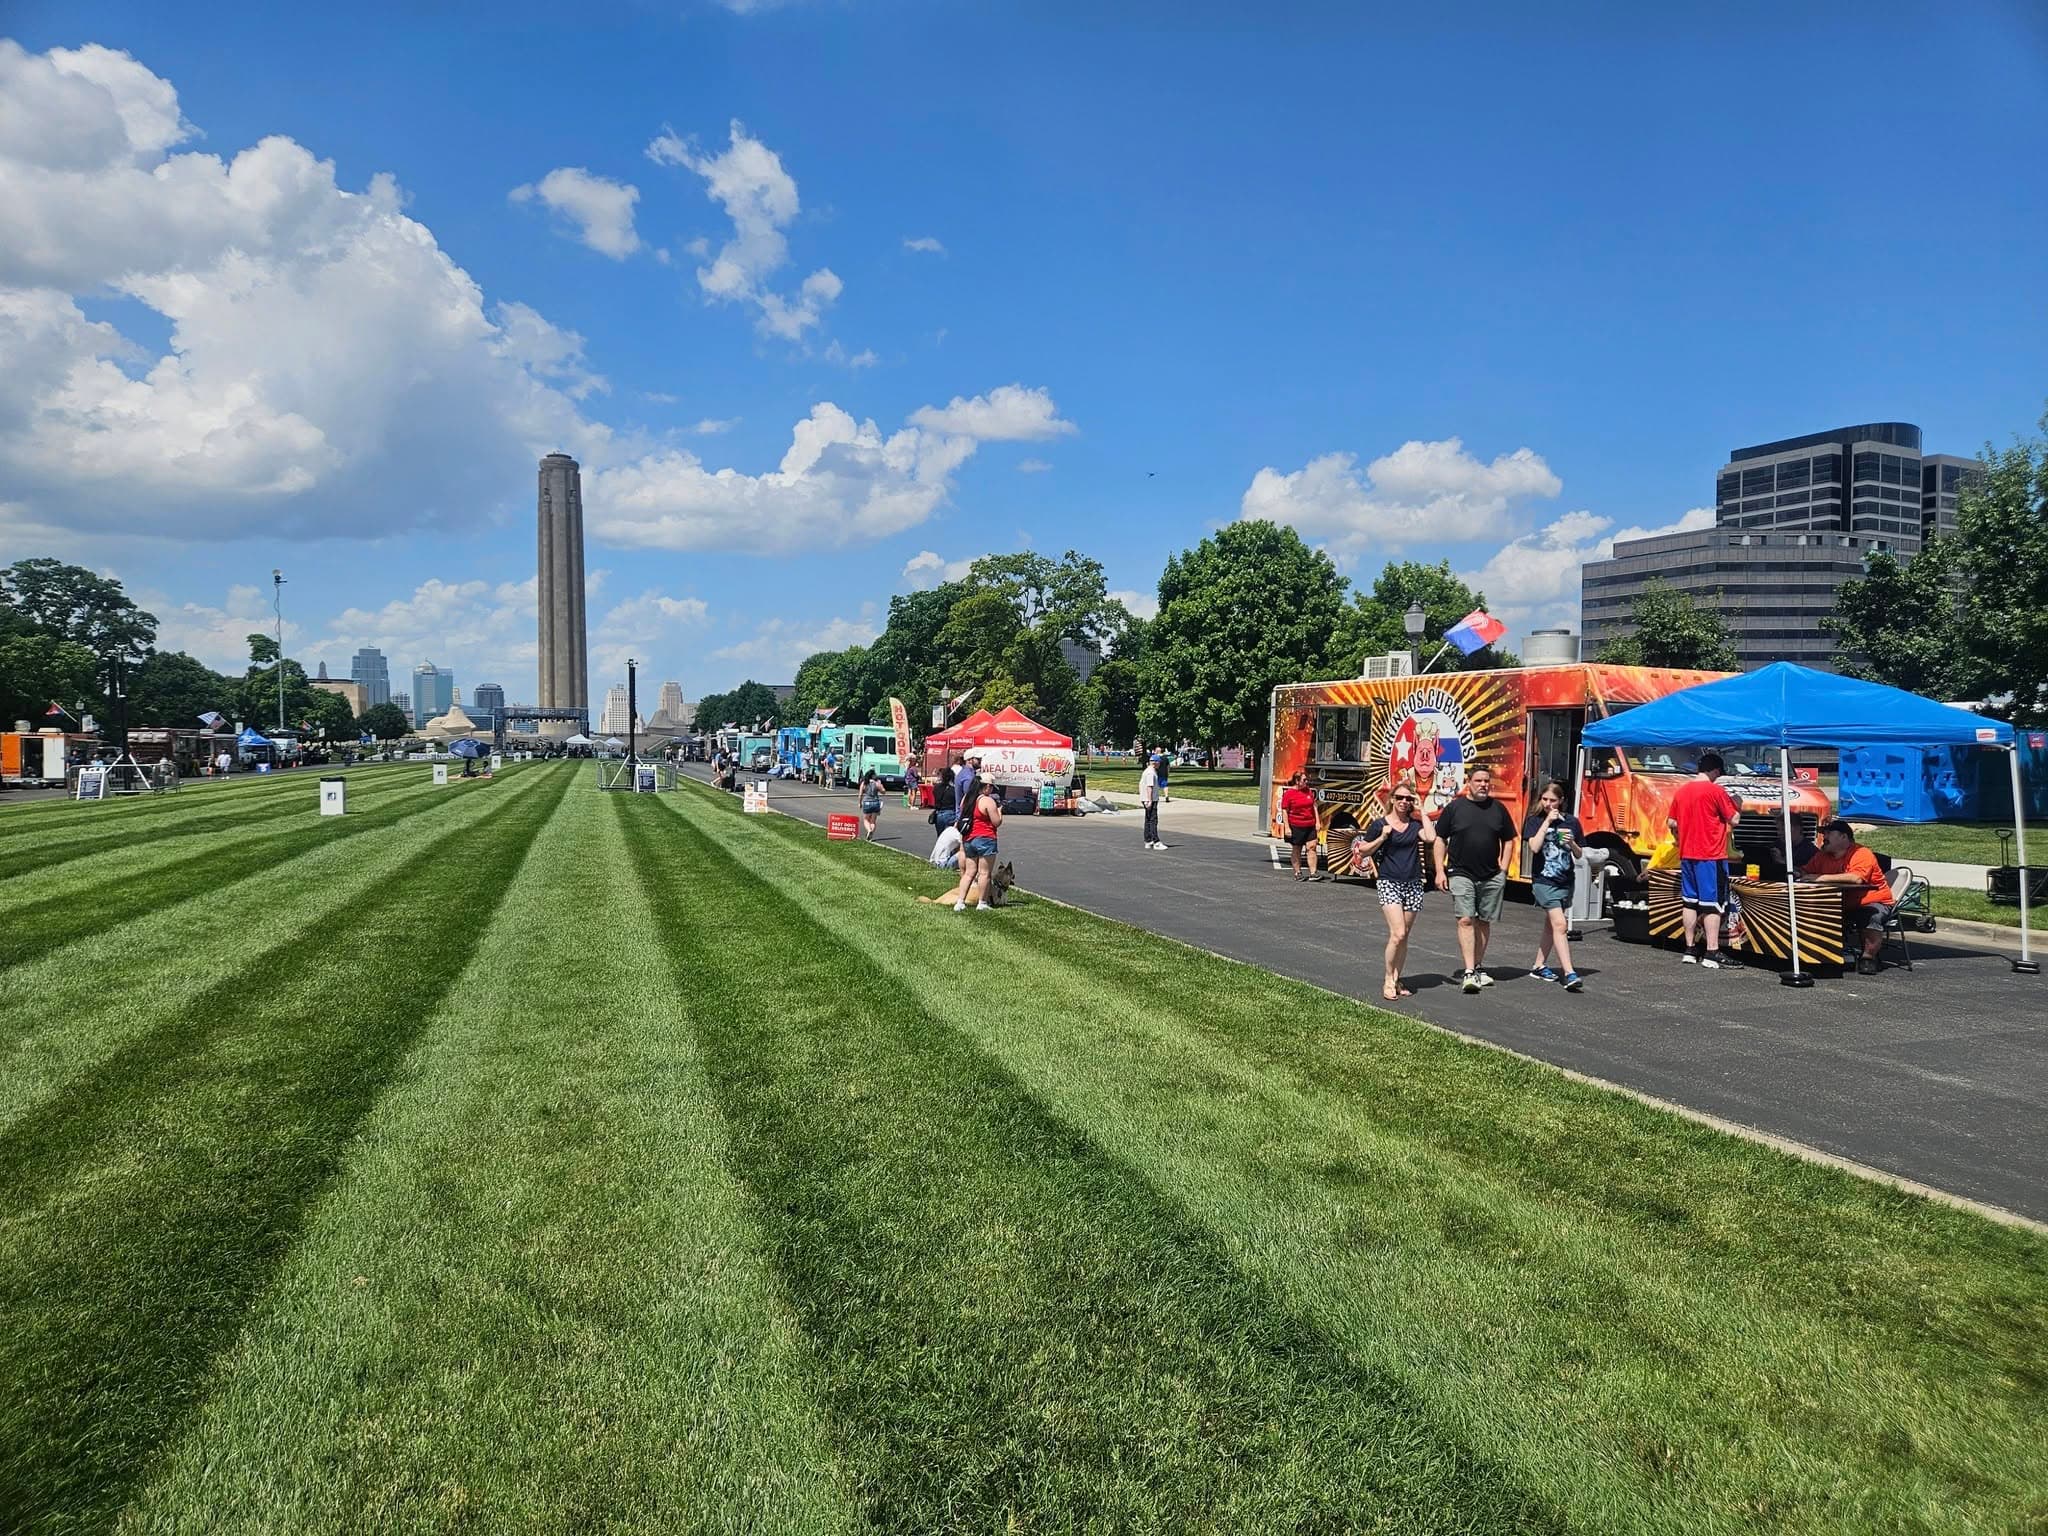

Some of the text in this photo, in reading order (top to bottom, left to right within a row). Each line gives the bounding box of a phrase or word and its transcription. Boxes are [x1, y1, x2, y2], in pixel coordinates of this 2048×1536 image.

[895, 705, 905, 729] HOT
[1380, 688, 1475, 760] GRINGOS CUBANOS
[982, 764, 1035, 773] MEAL DEAL
